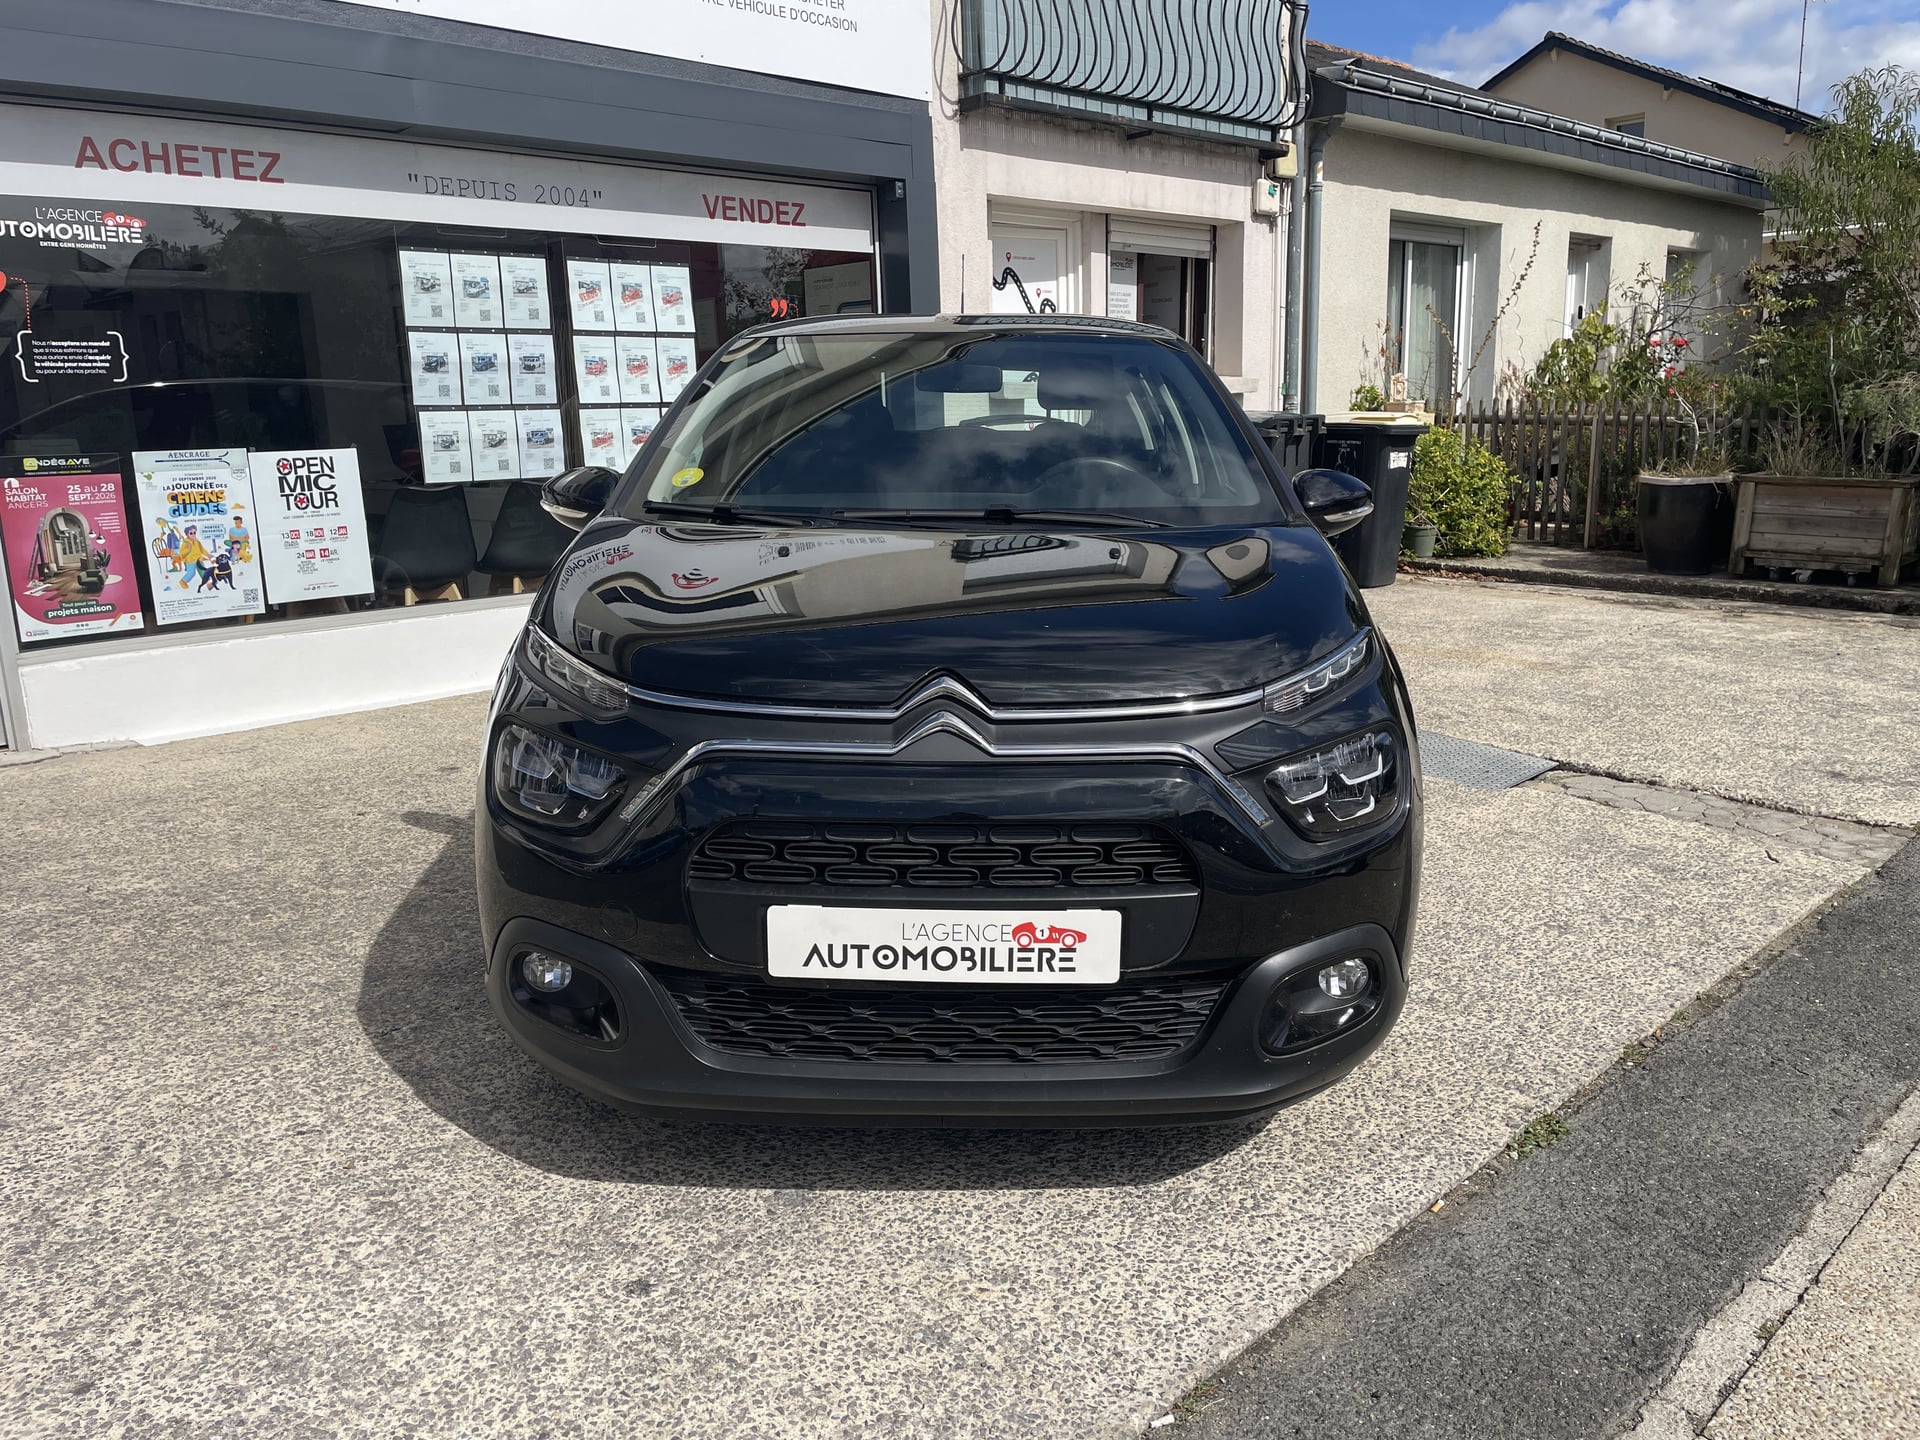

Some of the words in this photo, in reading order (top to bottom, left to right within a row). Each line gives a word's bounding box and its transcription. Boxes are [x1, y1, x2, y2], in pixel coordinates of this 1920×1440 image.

[799, 0, 845, 11] ETER
[789, 8, 858, 32] D'OCCASION
[75, 136, 285, 184] ACHETEZ
[35, 207, 103, 223] L'AGENCE
[702, 194, 806, 227] VENDEZ
[168, 451, 210, 459] AENCRAGE
[276, 456, 335, 476] OPEN
[67, 485, 81, 494] 25
[100, 483, 115, 492] 28
[171, 481, 215, 491] JOURNÉE
[278, 473, 336, 493] MIC
[5, 487, 38, 496] SALON
[6, 493, 47, 503] HABITAT
[68, 493, 94, 501] SEPT.
[95, 492, 116, 500] 2026
[166, 489, 226, 505] CHIENS
[8, 501, 48, 510] ANGERS
[280, 491, 339, 511] TOUR
[168, 503, 228, 518] GUIDES
[329, 528, 338, 536] 12
[320, 549, 329, 557] 14
[48, 608, 79, 618] projets
[80, 605, 112, 613] maison
[902, 922, 1012, 943] L'AGENCE
